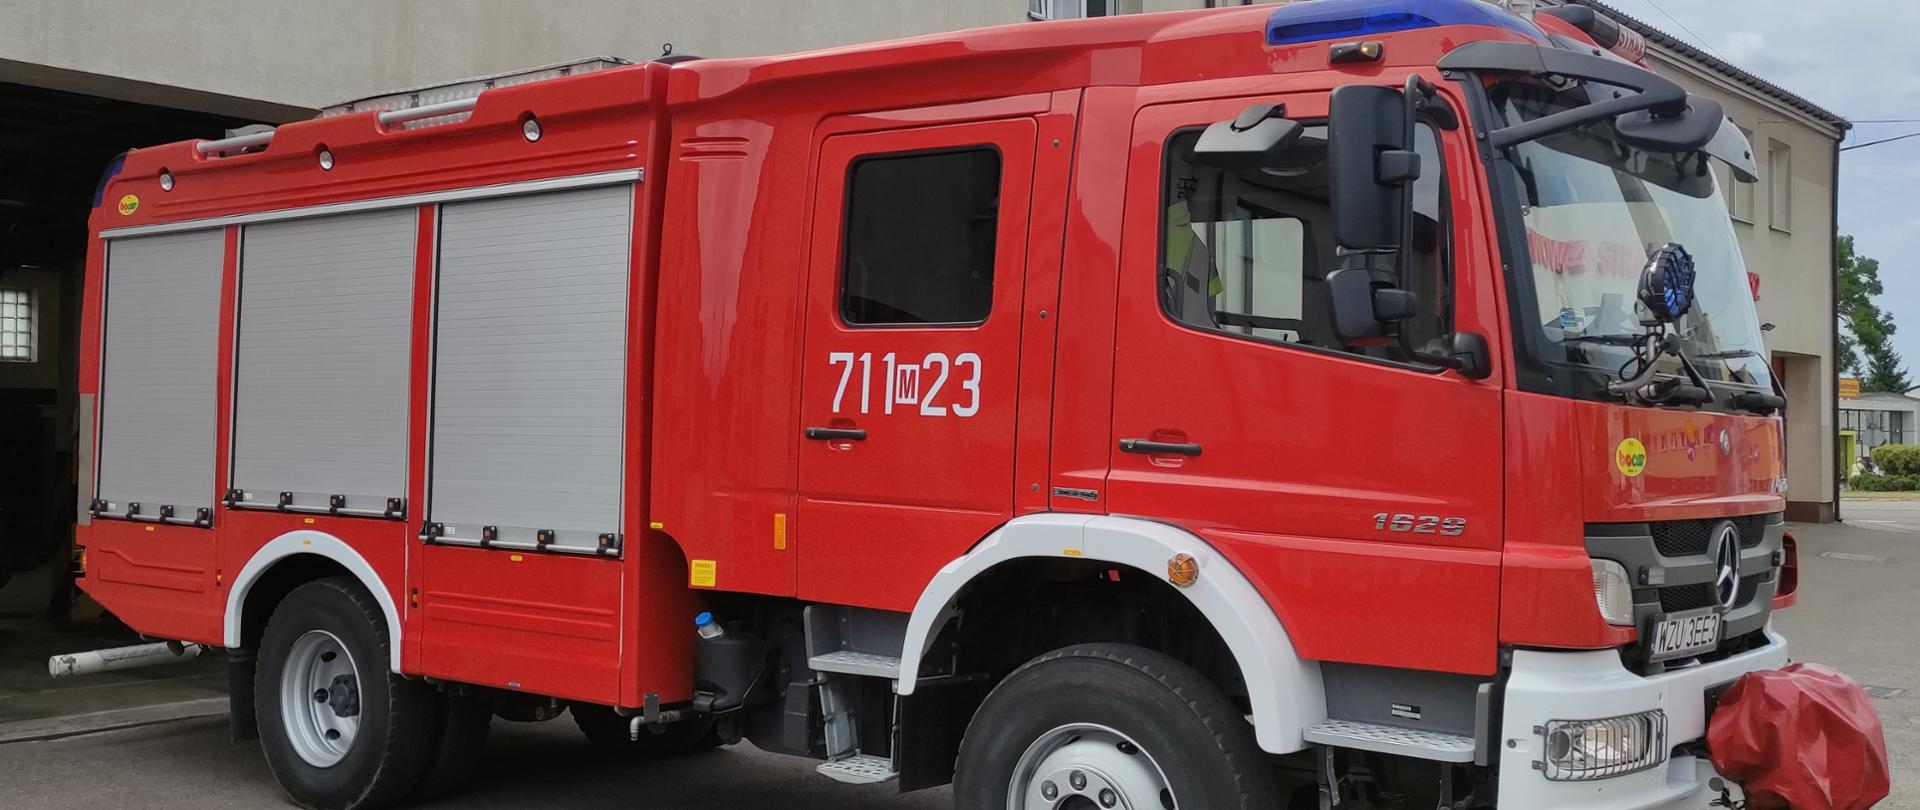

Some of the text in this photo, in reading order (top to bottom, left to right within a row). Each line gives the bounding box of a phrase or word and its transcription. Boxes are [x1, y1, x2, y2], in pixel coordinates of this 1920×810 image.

[1372, 512, 1466, 536] 1629
[1659, 615, 1717, 652] WZU 3EE3
